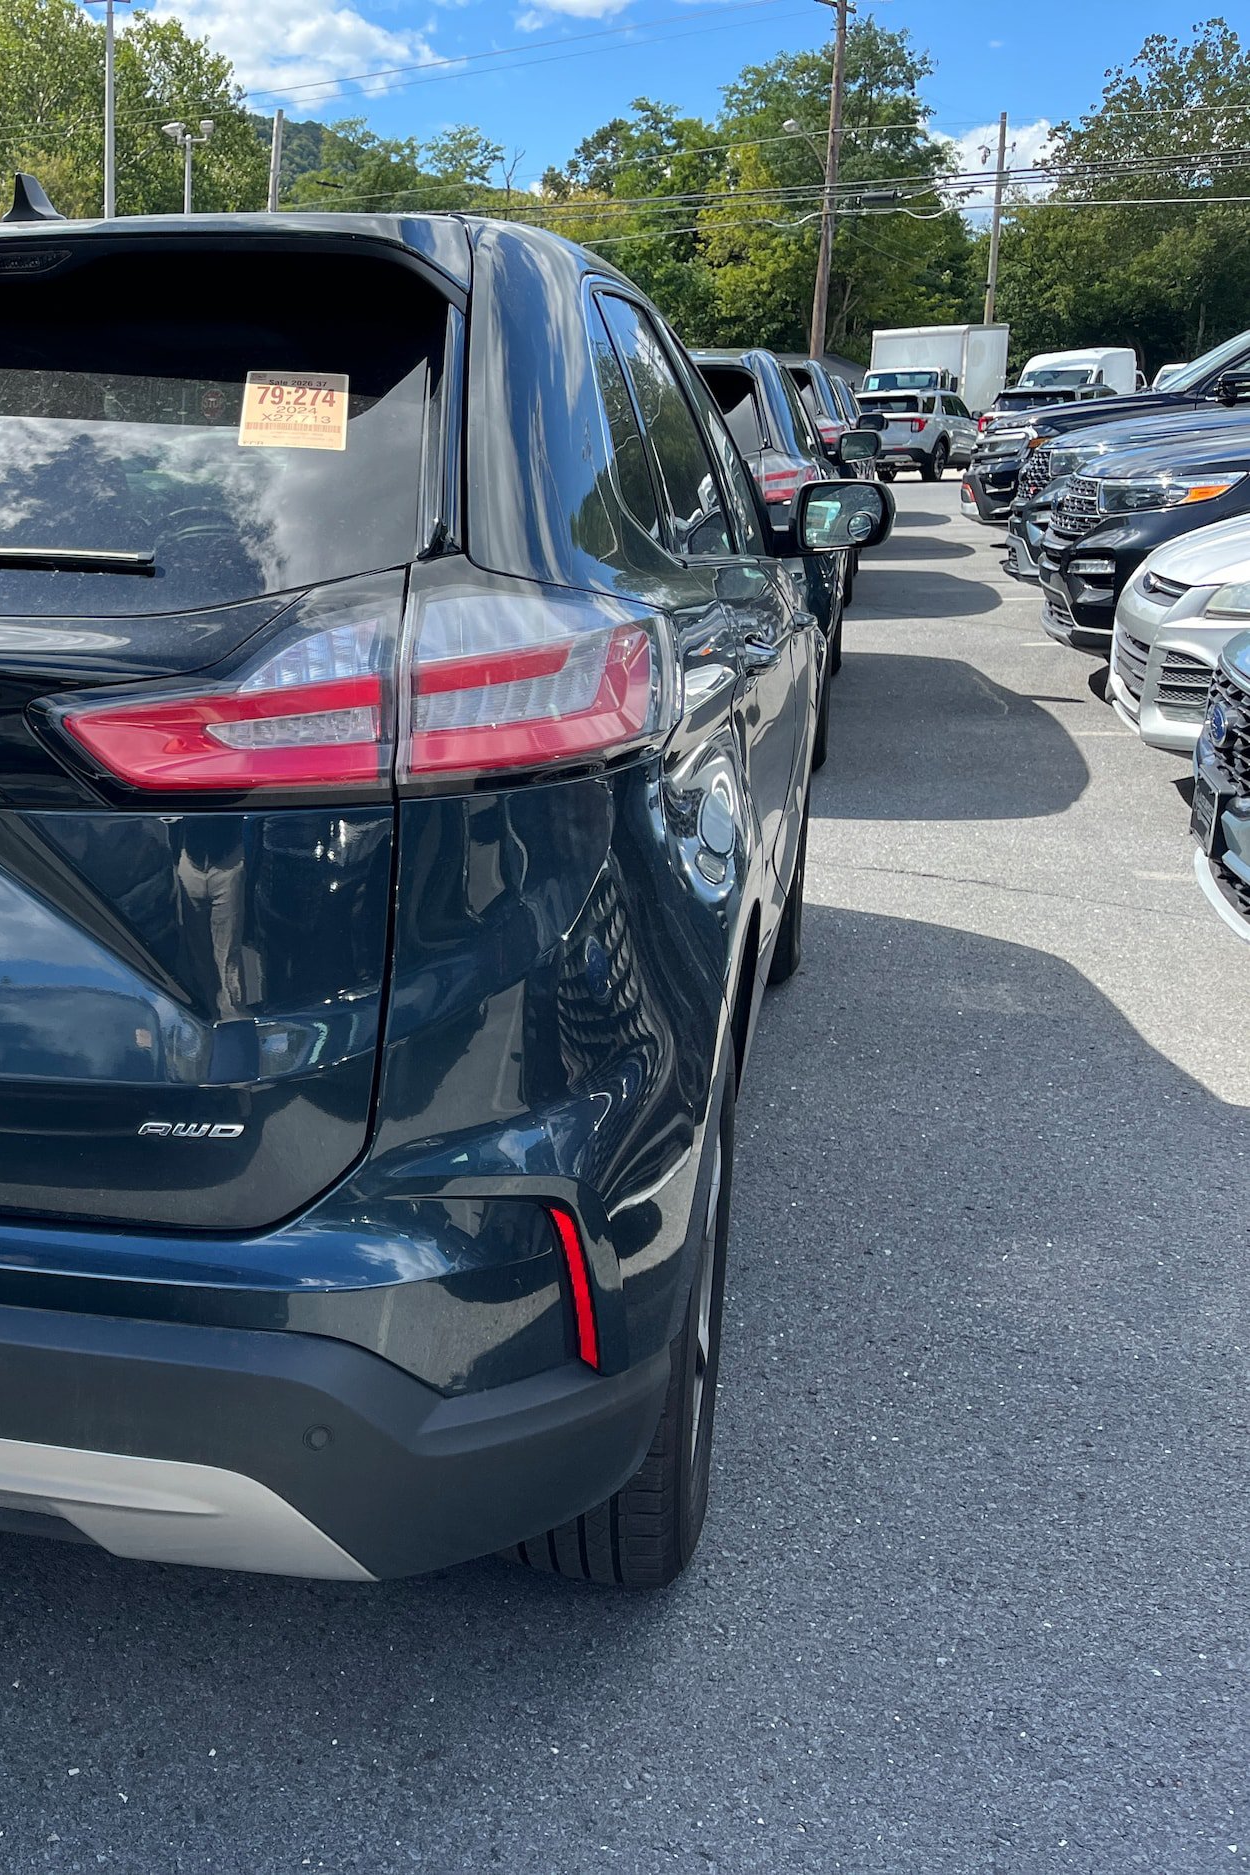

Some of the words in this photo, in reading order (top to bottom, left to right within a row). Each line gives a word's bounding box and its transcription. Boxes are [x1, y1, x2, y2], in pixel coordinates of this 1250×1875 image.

[257, 386, 335, 407] 79:274
[276, 406, 317, 414] 2024
[137, 1122, 245, 1138] AWD
